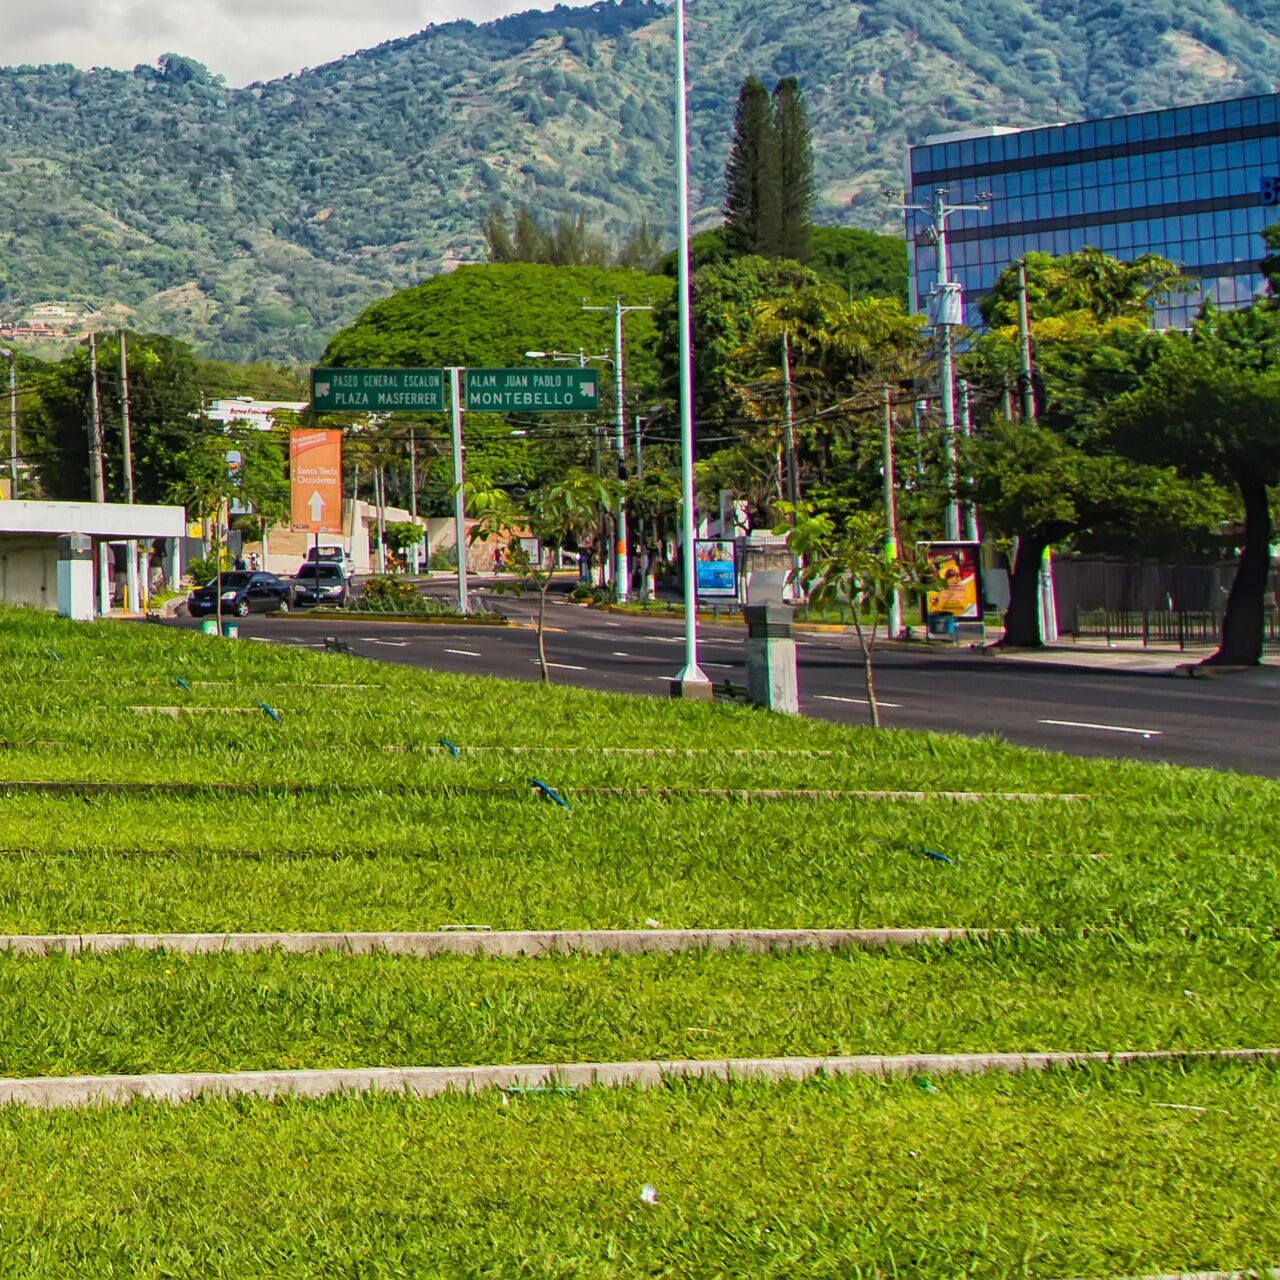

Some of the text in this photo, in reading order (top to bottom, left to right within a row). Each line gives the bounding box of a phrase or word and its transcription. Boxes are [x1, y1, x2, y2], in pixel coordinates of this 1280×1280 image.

[333, 375, 440, 387] PASEO GENERAL ESCALON
[504, 375, 528, 387] JUAN
[533, 375, 561, 387] PABLO
[567, 375, 573, 387] II
[335, 393, 437, 405] PLAZA MASFERRER
[470, 392, 573, 405] MONTEBELLO
[297, 466, 317, 475] Santa
[297, 476, 337, 485] Occidente
